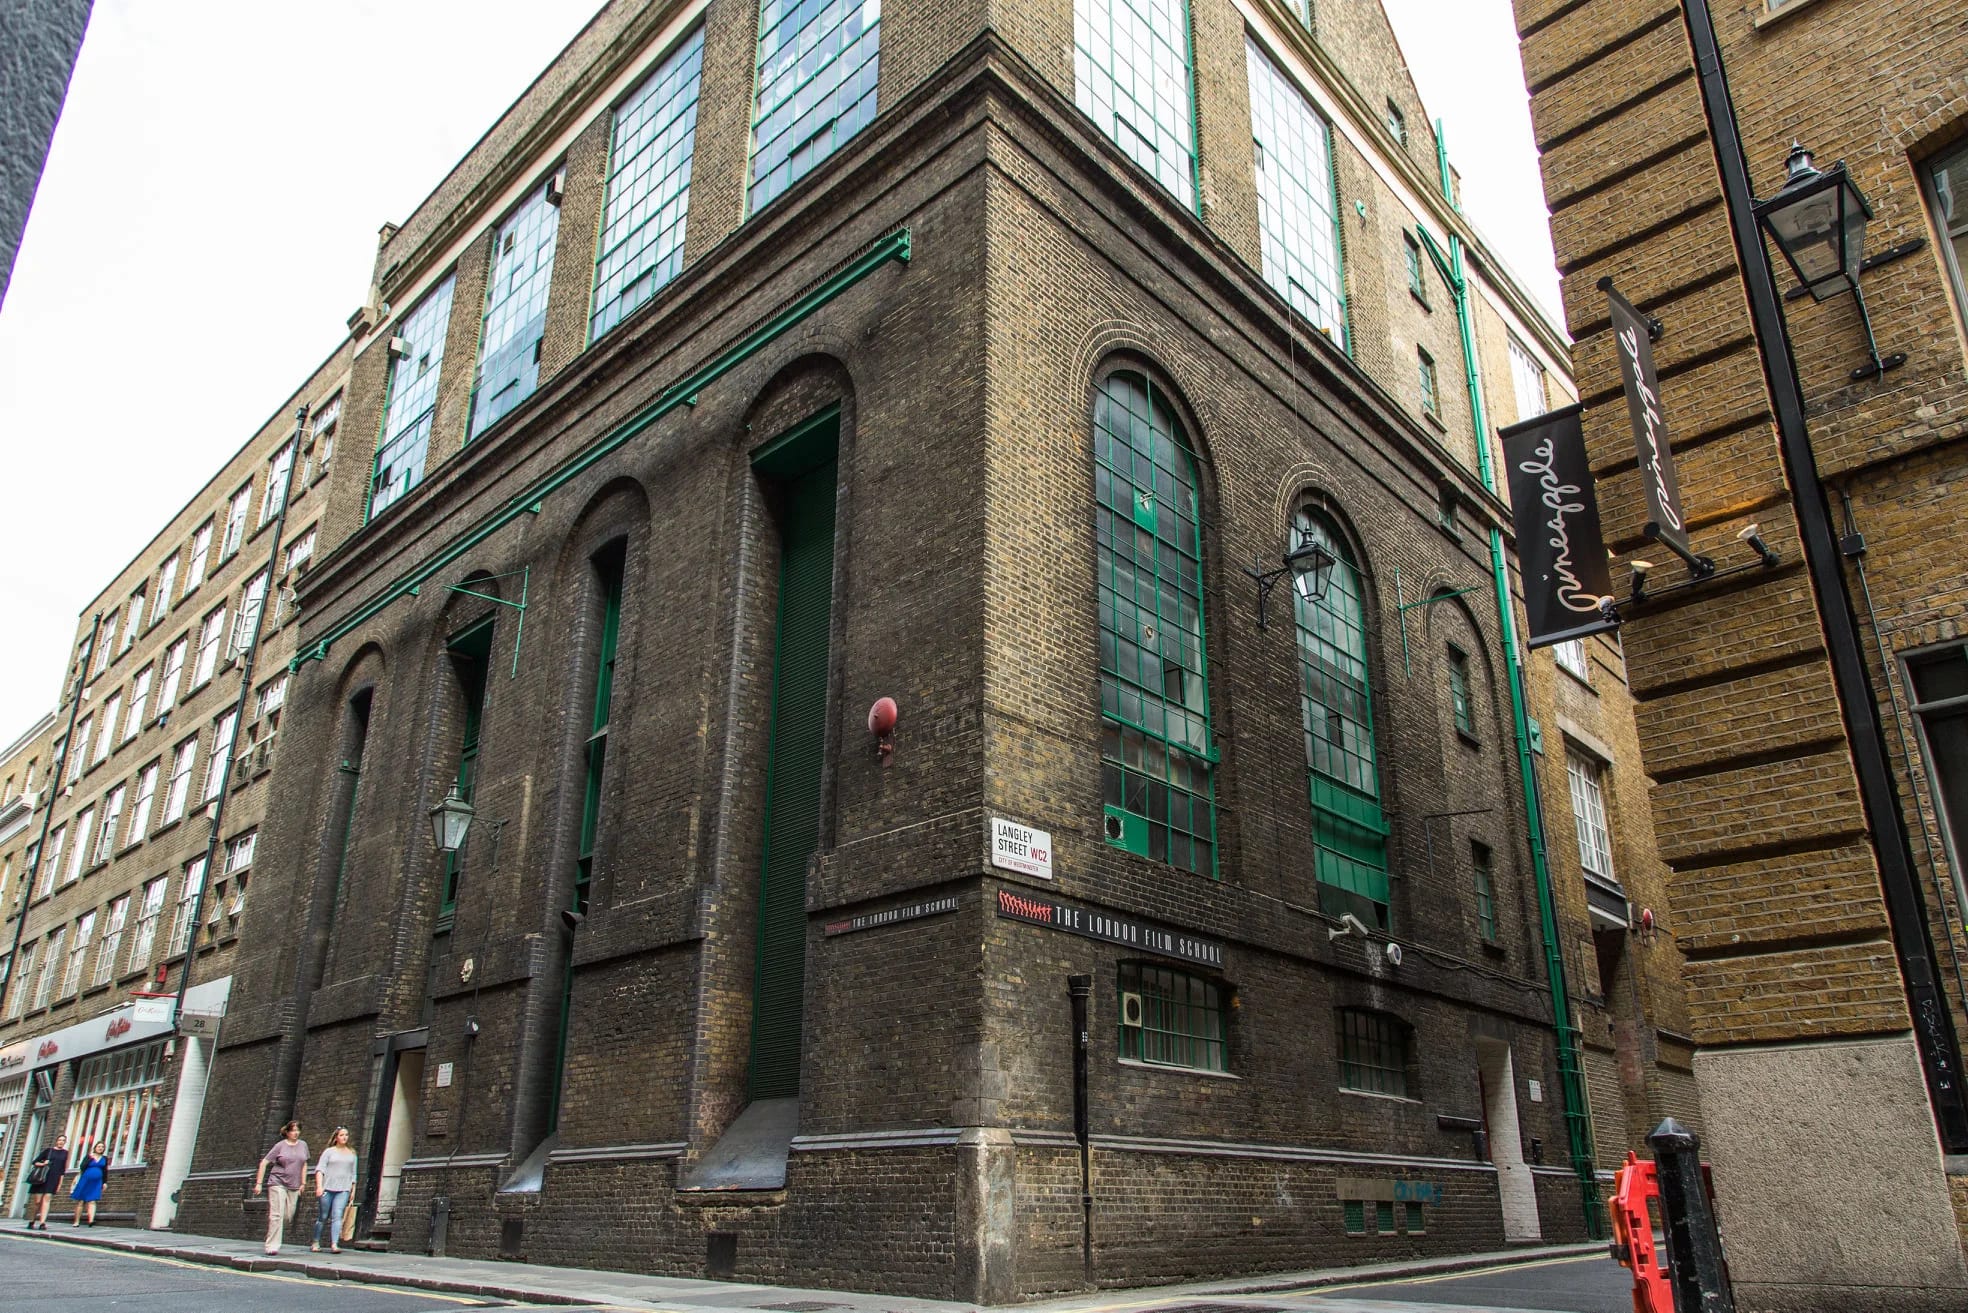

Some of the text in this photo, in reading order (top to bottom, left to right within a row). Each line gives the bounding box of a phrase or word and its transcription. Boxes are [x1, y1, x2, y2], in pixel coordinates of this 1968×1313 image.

[998, 824, 1033, 844] LANGLEY
[998, 838, 1048, 863] STREET WC2
[1013, 862, 1039, 872] WESTMINSTER
[853, 897, 956, 929] THE LONDON FILM SCHOOL
[1055, 906, 1222, 964] THE LONDON FILM SCHOOL
